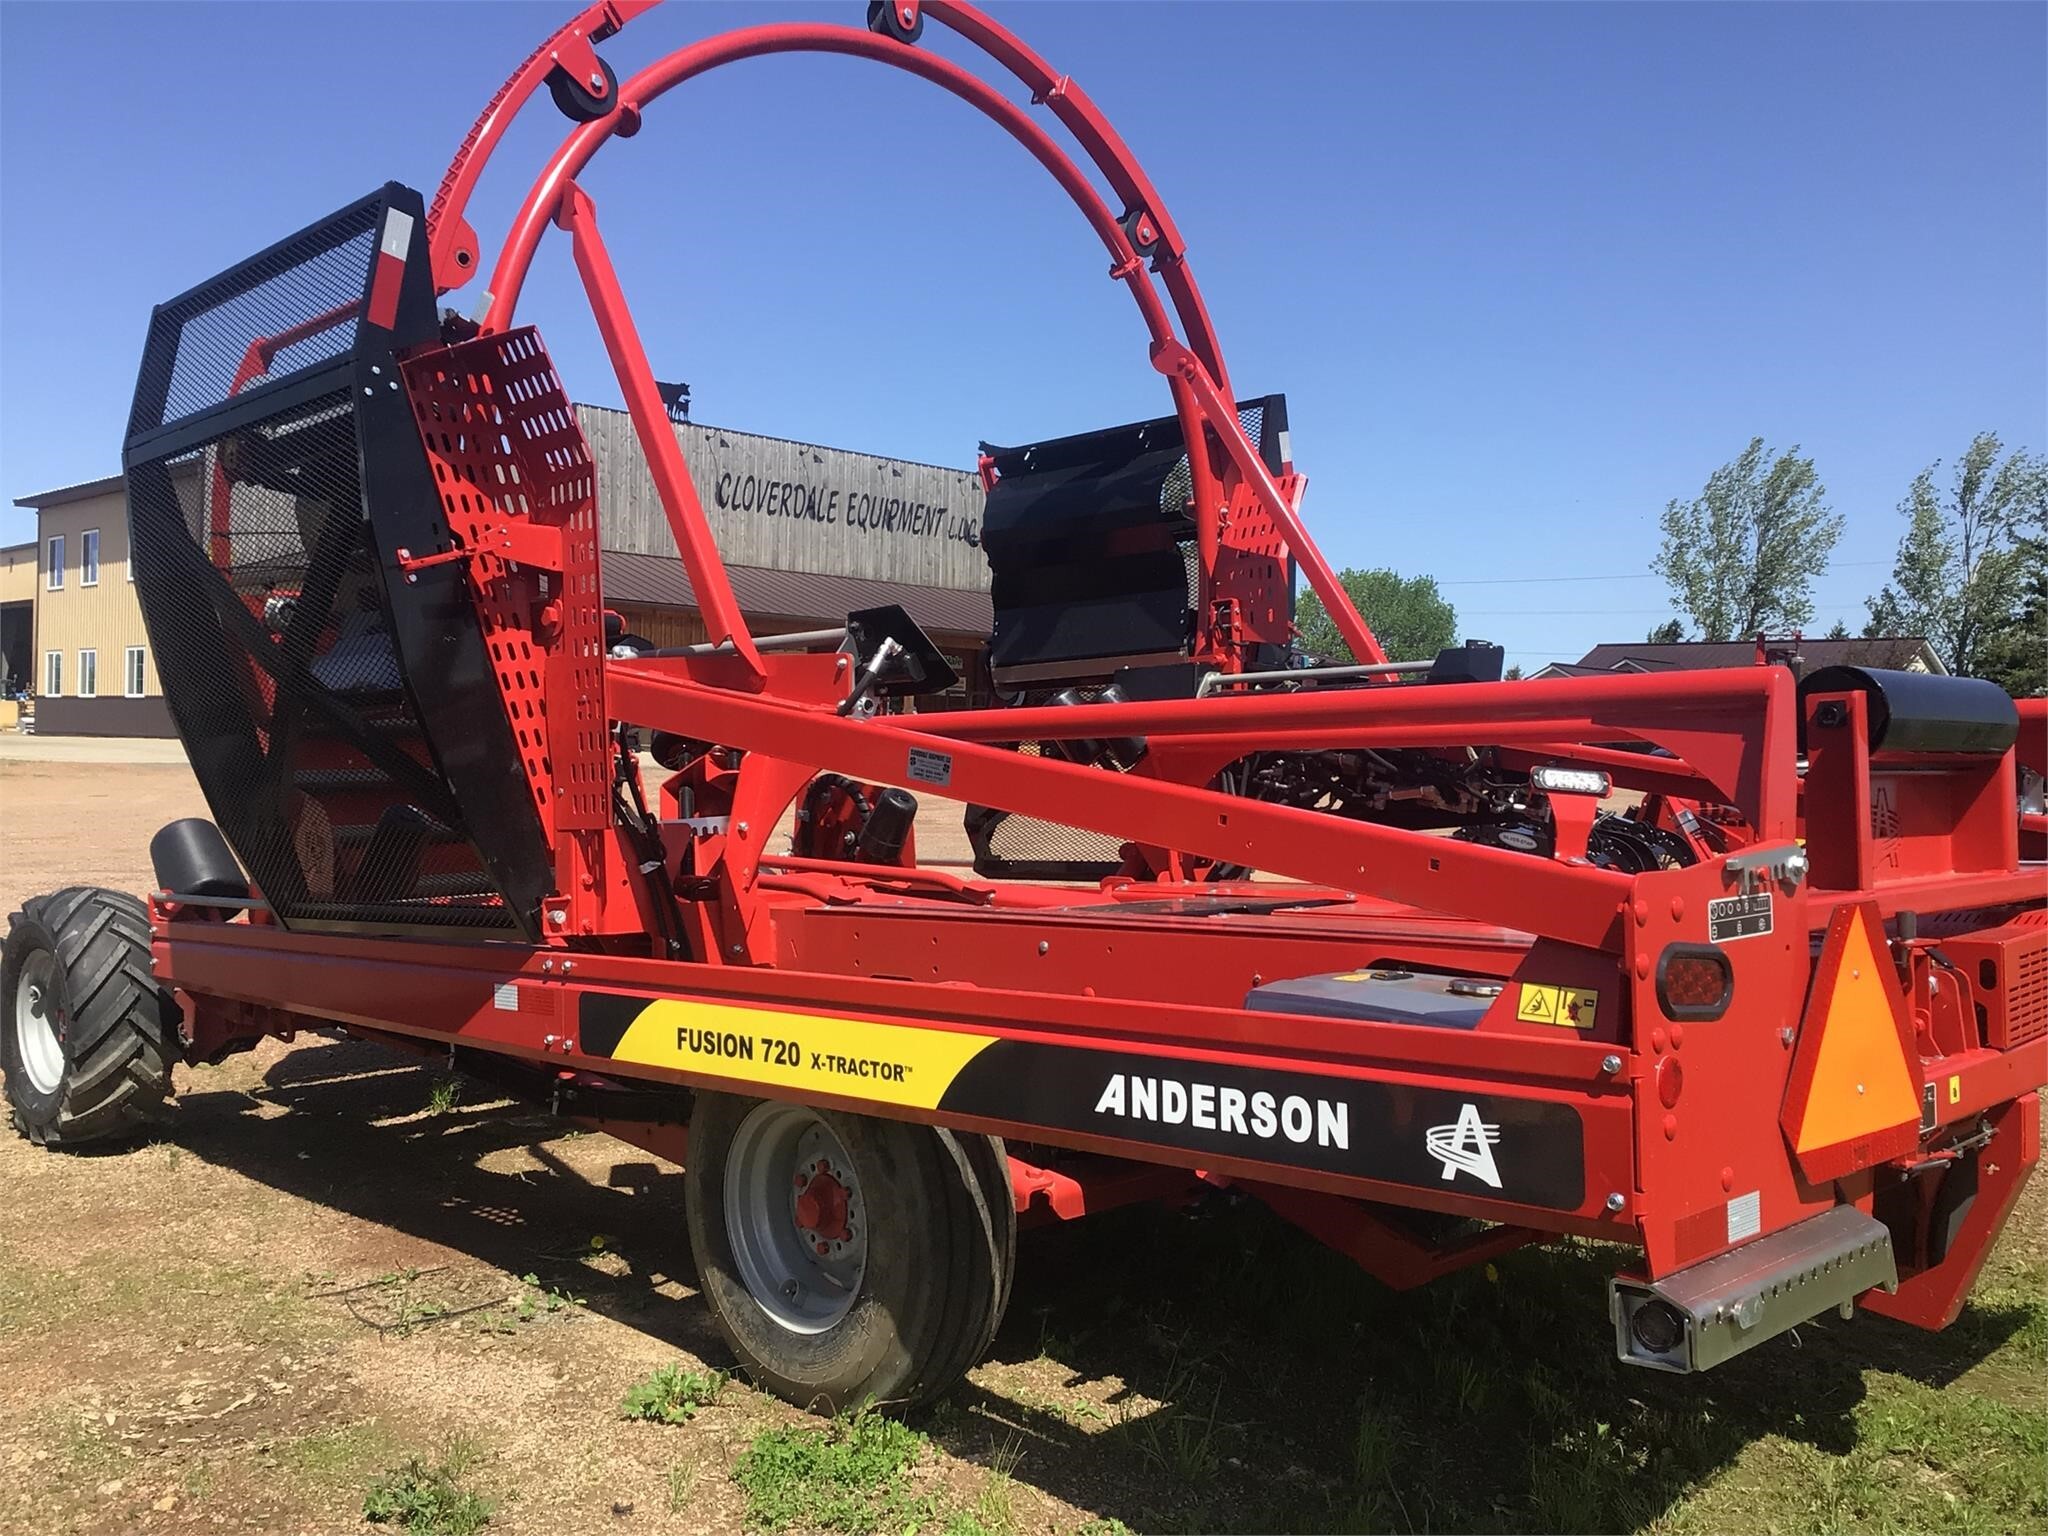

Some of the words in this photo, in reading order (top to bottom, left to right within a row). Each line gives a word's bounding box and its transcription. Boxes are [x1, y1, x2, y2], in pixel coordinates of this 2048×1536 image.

[718, 472, 838, 524] CLOVERDALE
[847, 492, 947, 538] EQUIPMENT
[677, 1028, 753, 1060] FUSION
[761, 1038, 800, 1067] 720
[1095, 1074, 1349, 1149] ANDERSON
